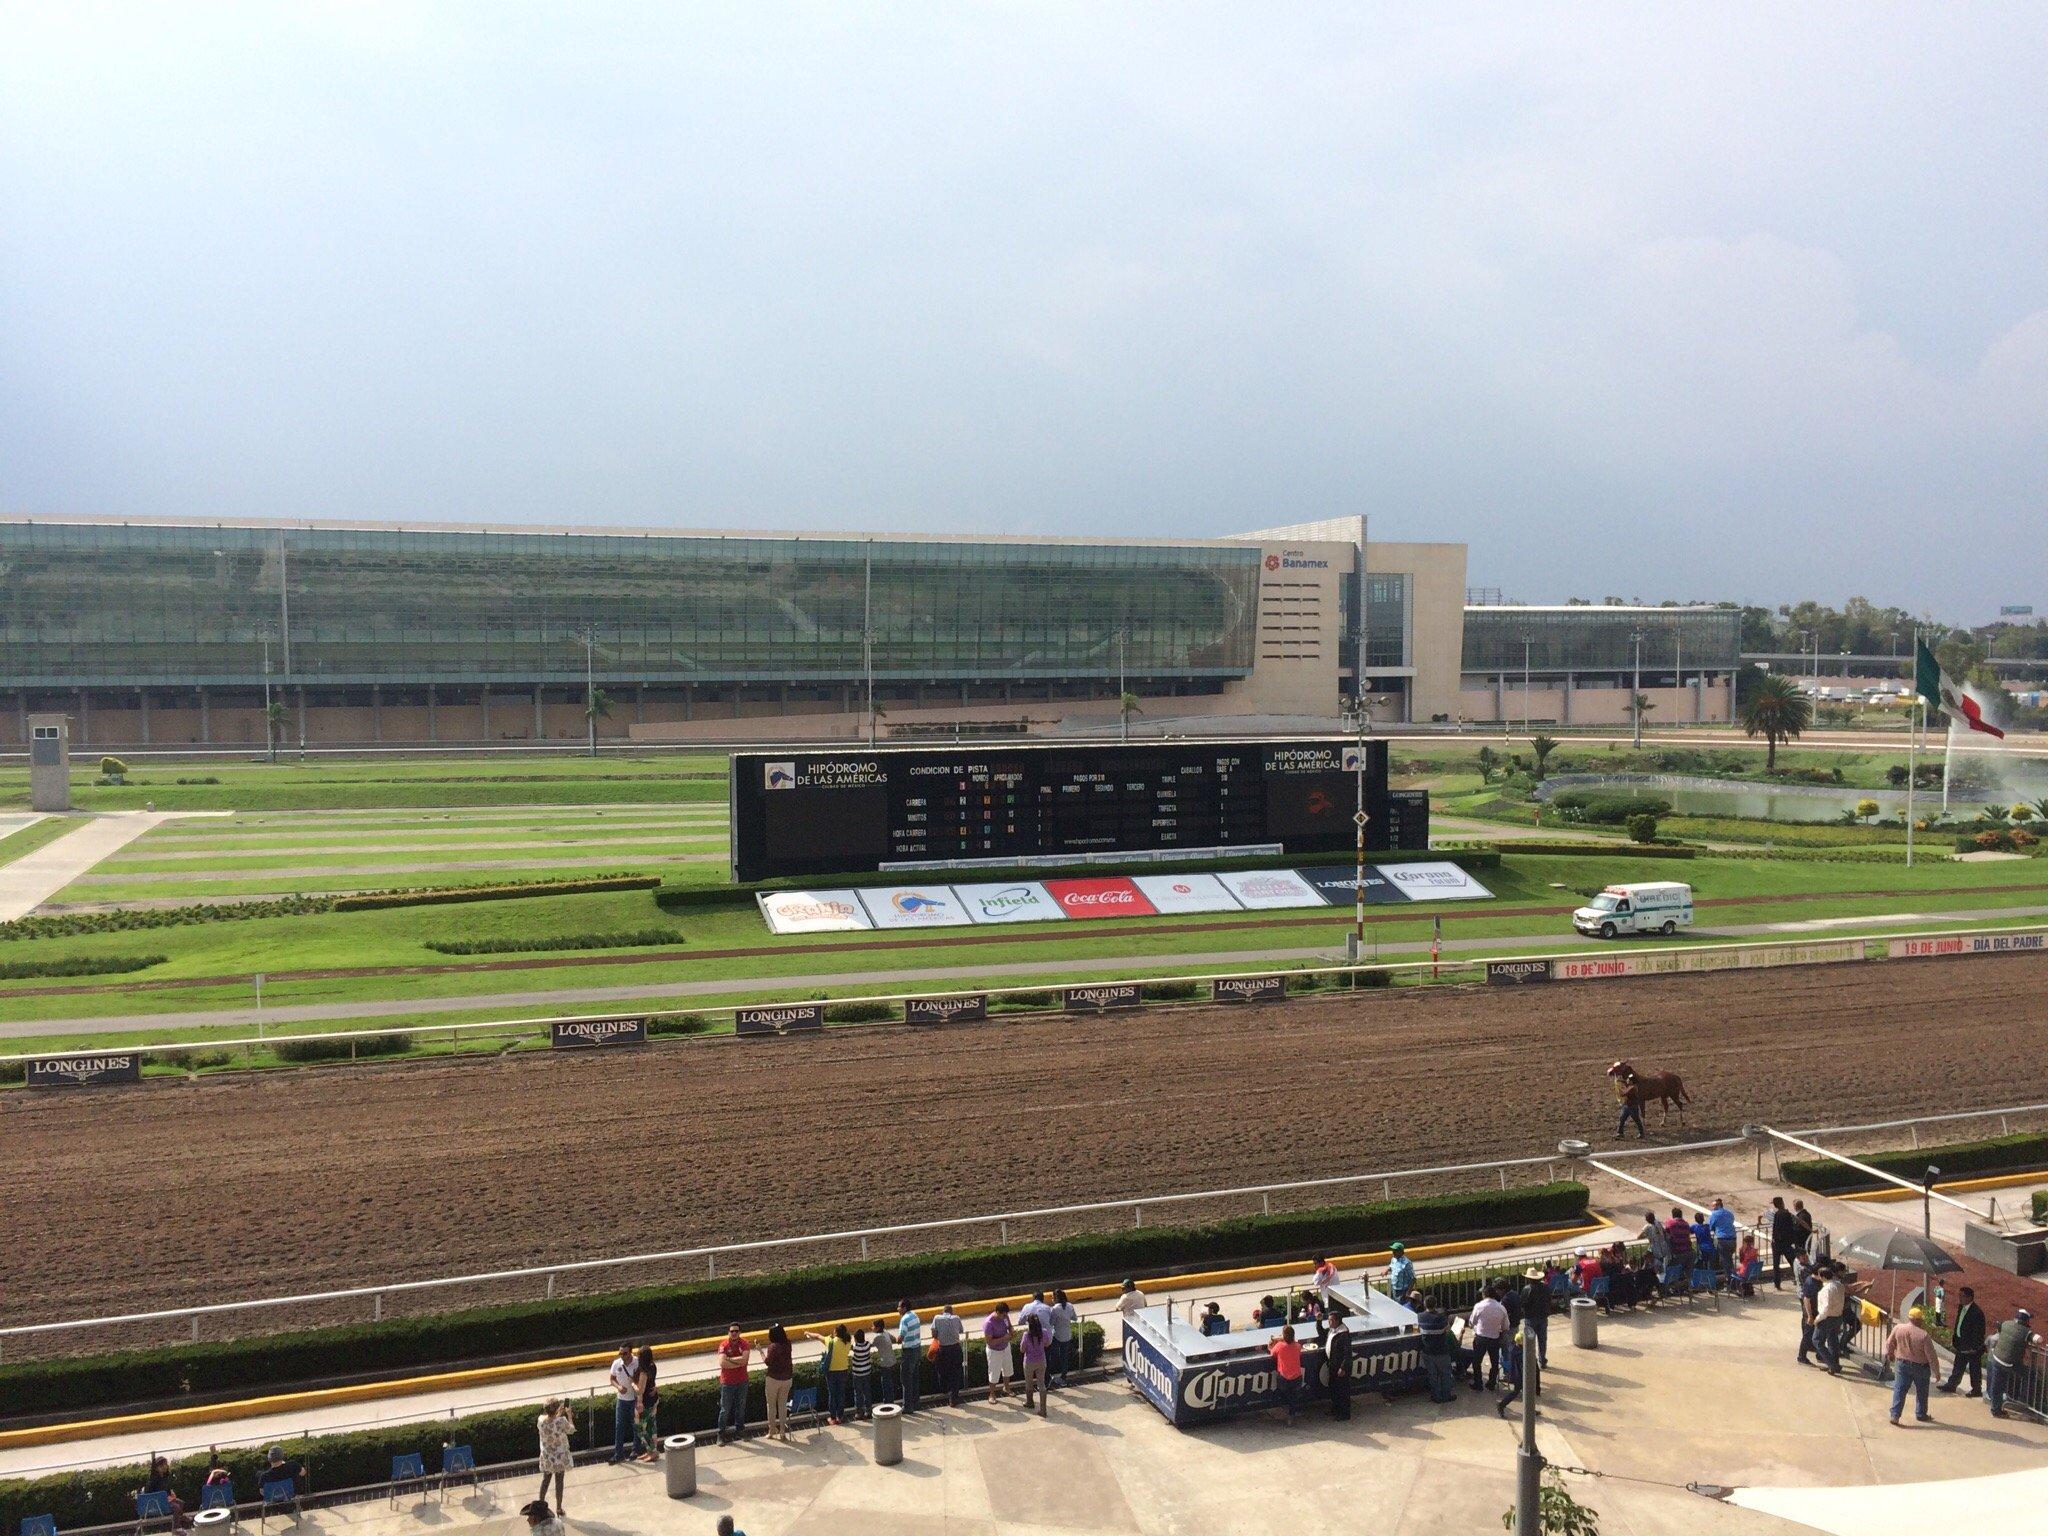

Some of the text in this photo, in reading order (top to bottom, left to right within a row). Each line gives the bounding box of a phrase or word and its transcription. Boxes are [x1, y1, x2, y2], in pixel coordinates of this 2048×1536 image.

[1282, 559, 1328, 569] Banamex
[1274, 749, 1332, 761] HIPÓDROMO
[808, 761, 878, 775] HIPÓDROMO
[910, 765, 989, 776] CONDICION DE PISTA
[1265, 760, 1340, 771] DE LAS AMÉRICAS
[797, 773, 888, 785] DE LAS AMÉRICAS
[1394, 871, 1452, 882] Corona
[1064, 889, 1134, 906] Coca-Cola
[1905, 942, 1917, 955] 19
[1921, 942, 1933, 953] DE
[1974, 939, 1990, 951] DIA
[1993, 938, 2010, 949] DEL
[2013, 935, 2044, 948] PADRE
[1491, 962, 1545, 974] LONGINES
[1565, 964, 1577, 976] 18
[1581, 964, 1593, 975] DE
[1596, 962, 1625, 974] JUNIO
[1218, 978, 1280, 991] LONGINES
[1070, 986, 1135, 1000] LONGINES
[910, 998, 980, 1012] LONGINES
[741, 1007, 816, 1023] LONGINES
[558, 1020, 638, 1036] LONGINES
[34, 1056, 130, 1073] LONGINES
[1125, 1336, 1173, 1402] Corona
[1184, 1369, 1306, 1410] Coro
